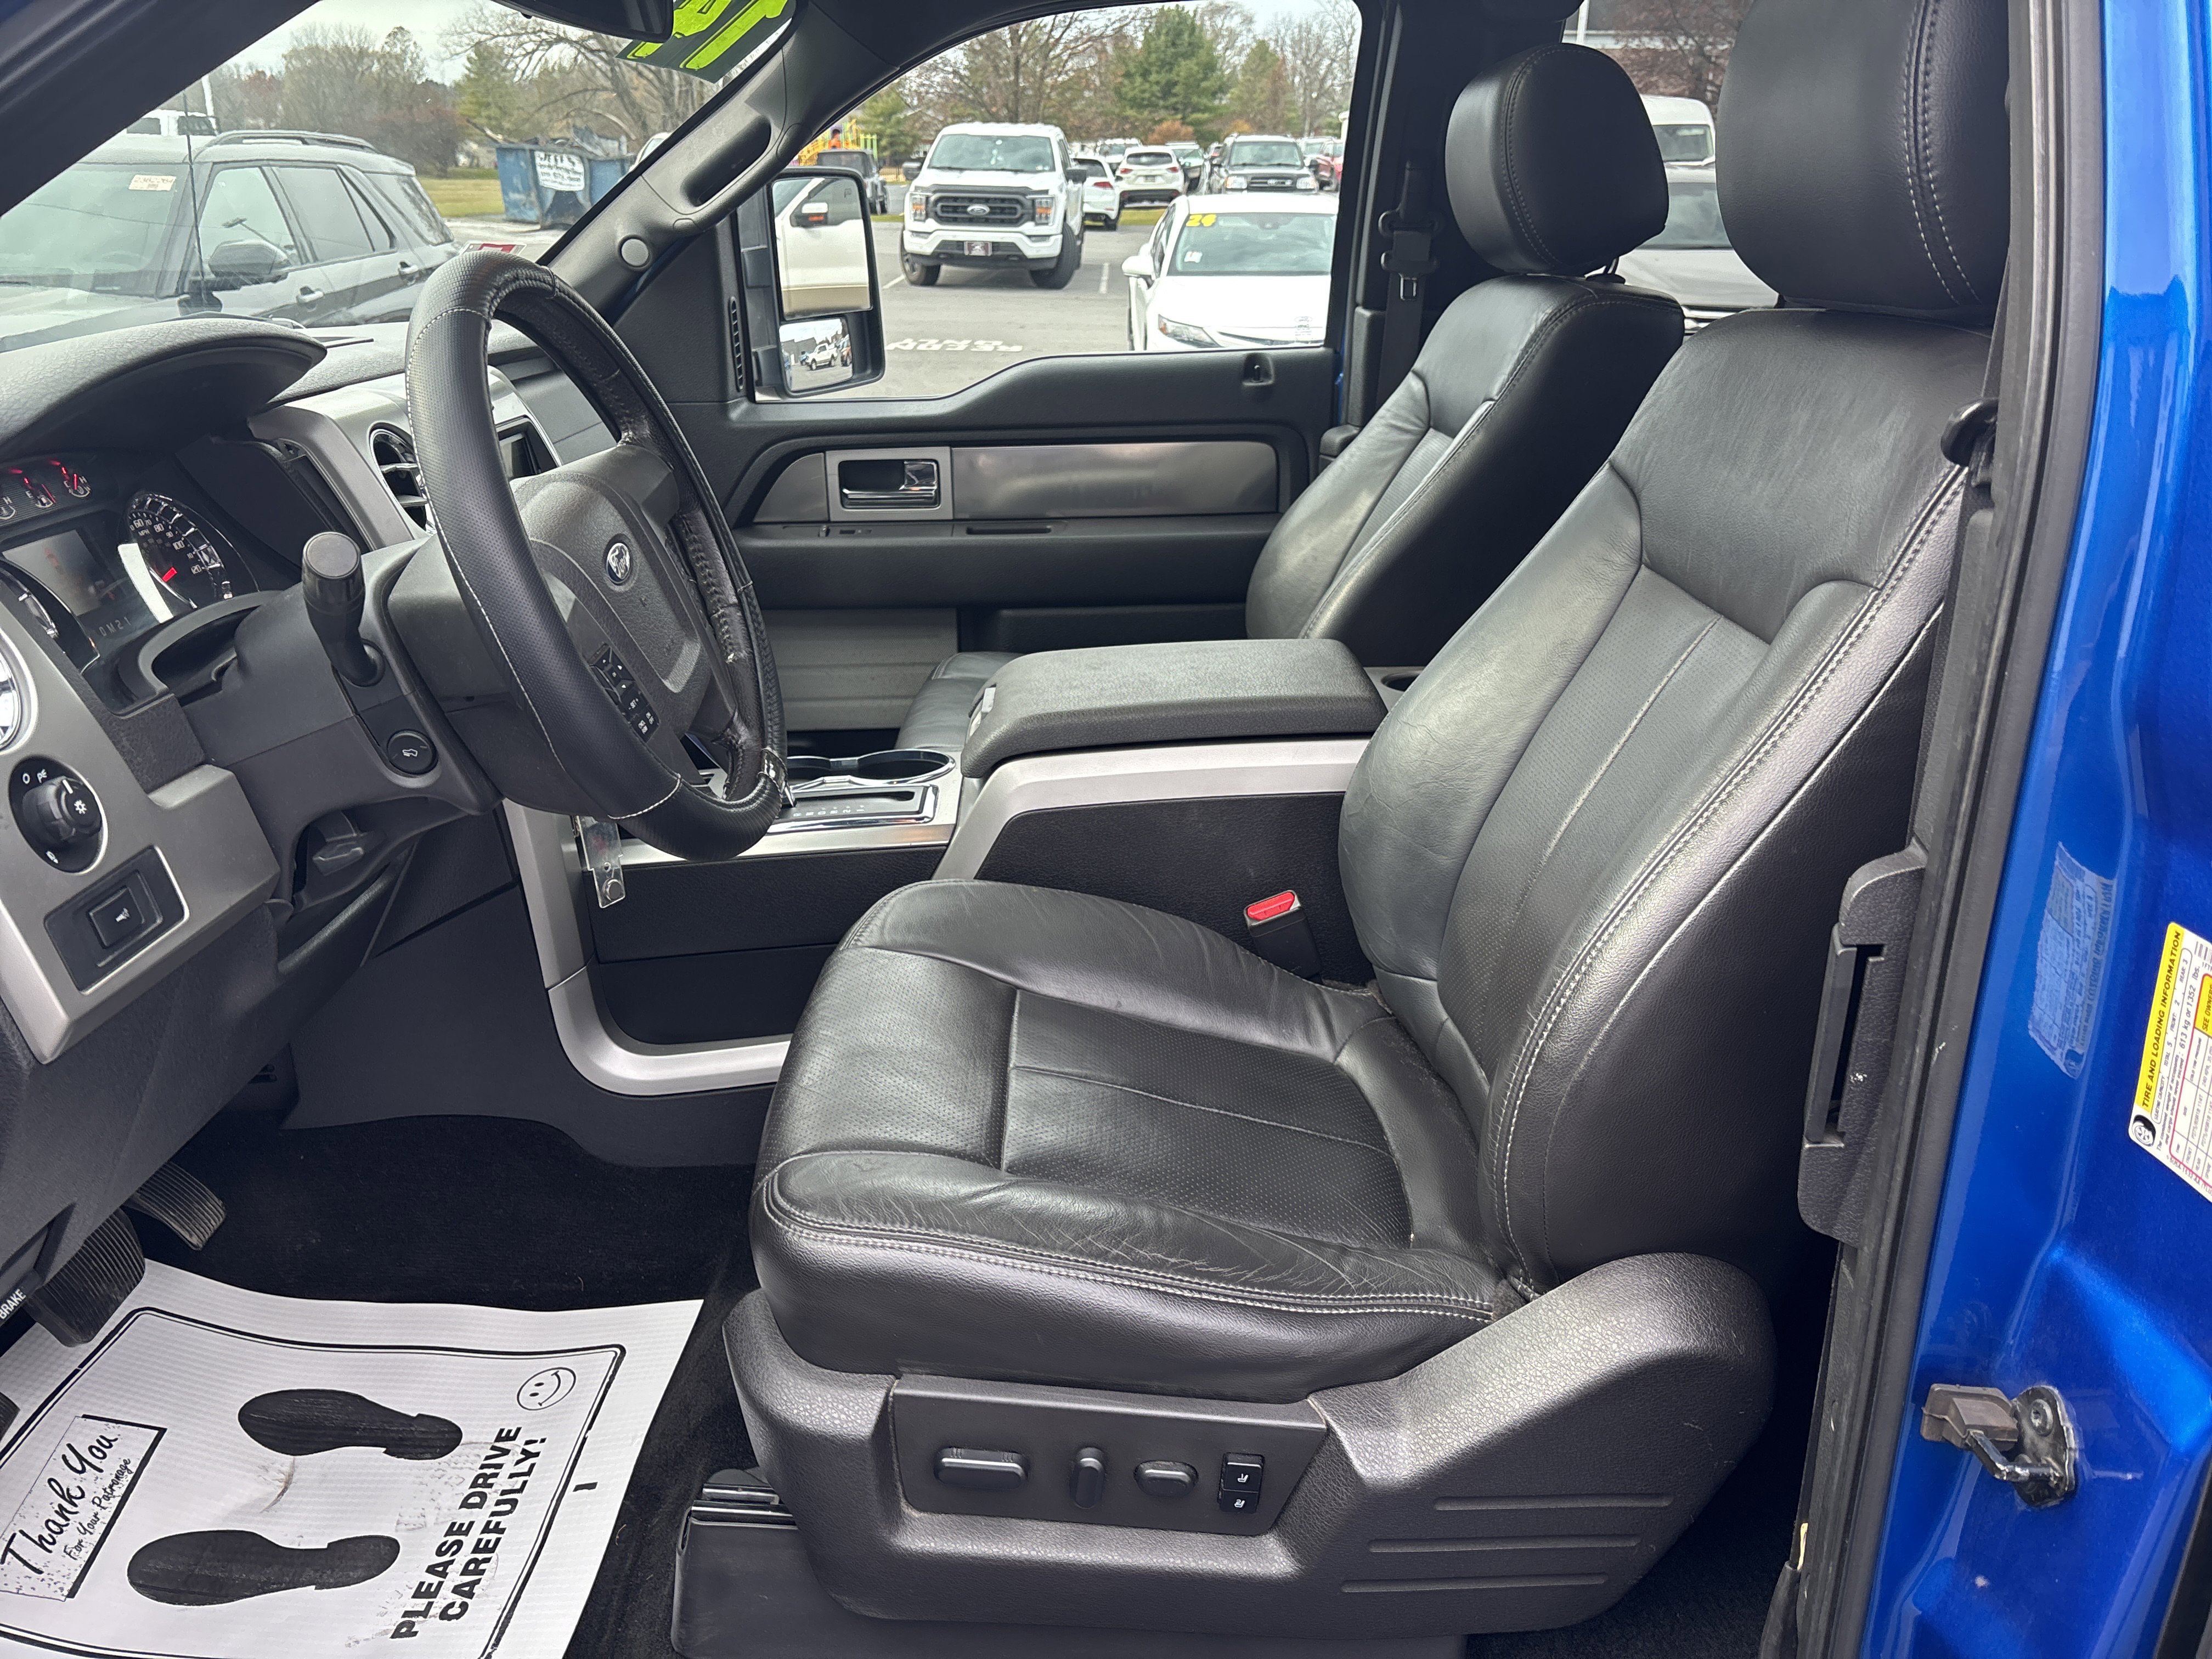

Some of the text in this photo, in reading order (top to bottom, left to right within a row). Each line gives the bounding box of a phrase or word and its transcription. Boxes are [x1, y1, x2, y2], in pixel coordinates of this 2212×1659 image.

[133, 518, 144, 528] 60
[154, 523, 165, 533] 80
[2187, 985, 2196, 1007] 1352
[2142, 930, 2181, 1108] TIRE AND LOADING INFORMATION
[2182, 1019, 2191, 1031] kg
[2186, 1008, 2191, 1018] or
[2179, 1031, 2187, 1049] 613
[0, 1289, 26, 1319] BRAKE
[1, 1435, 119, 1575] Thank You
[64, 1458, 134, 1561] For Your Patronage
[390, 1426, 523, 1639] PLEASE DRIVE
[439, 1437, 548, 1622] CAREFULLY!
